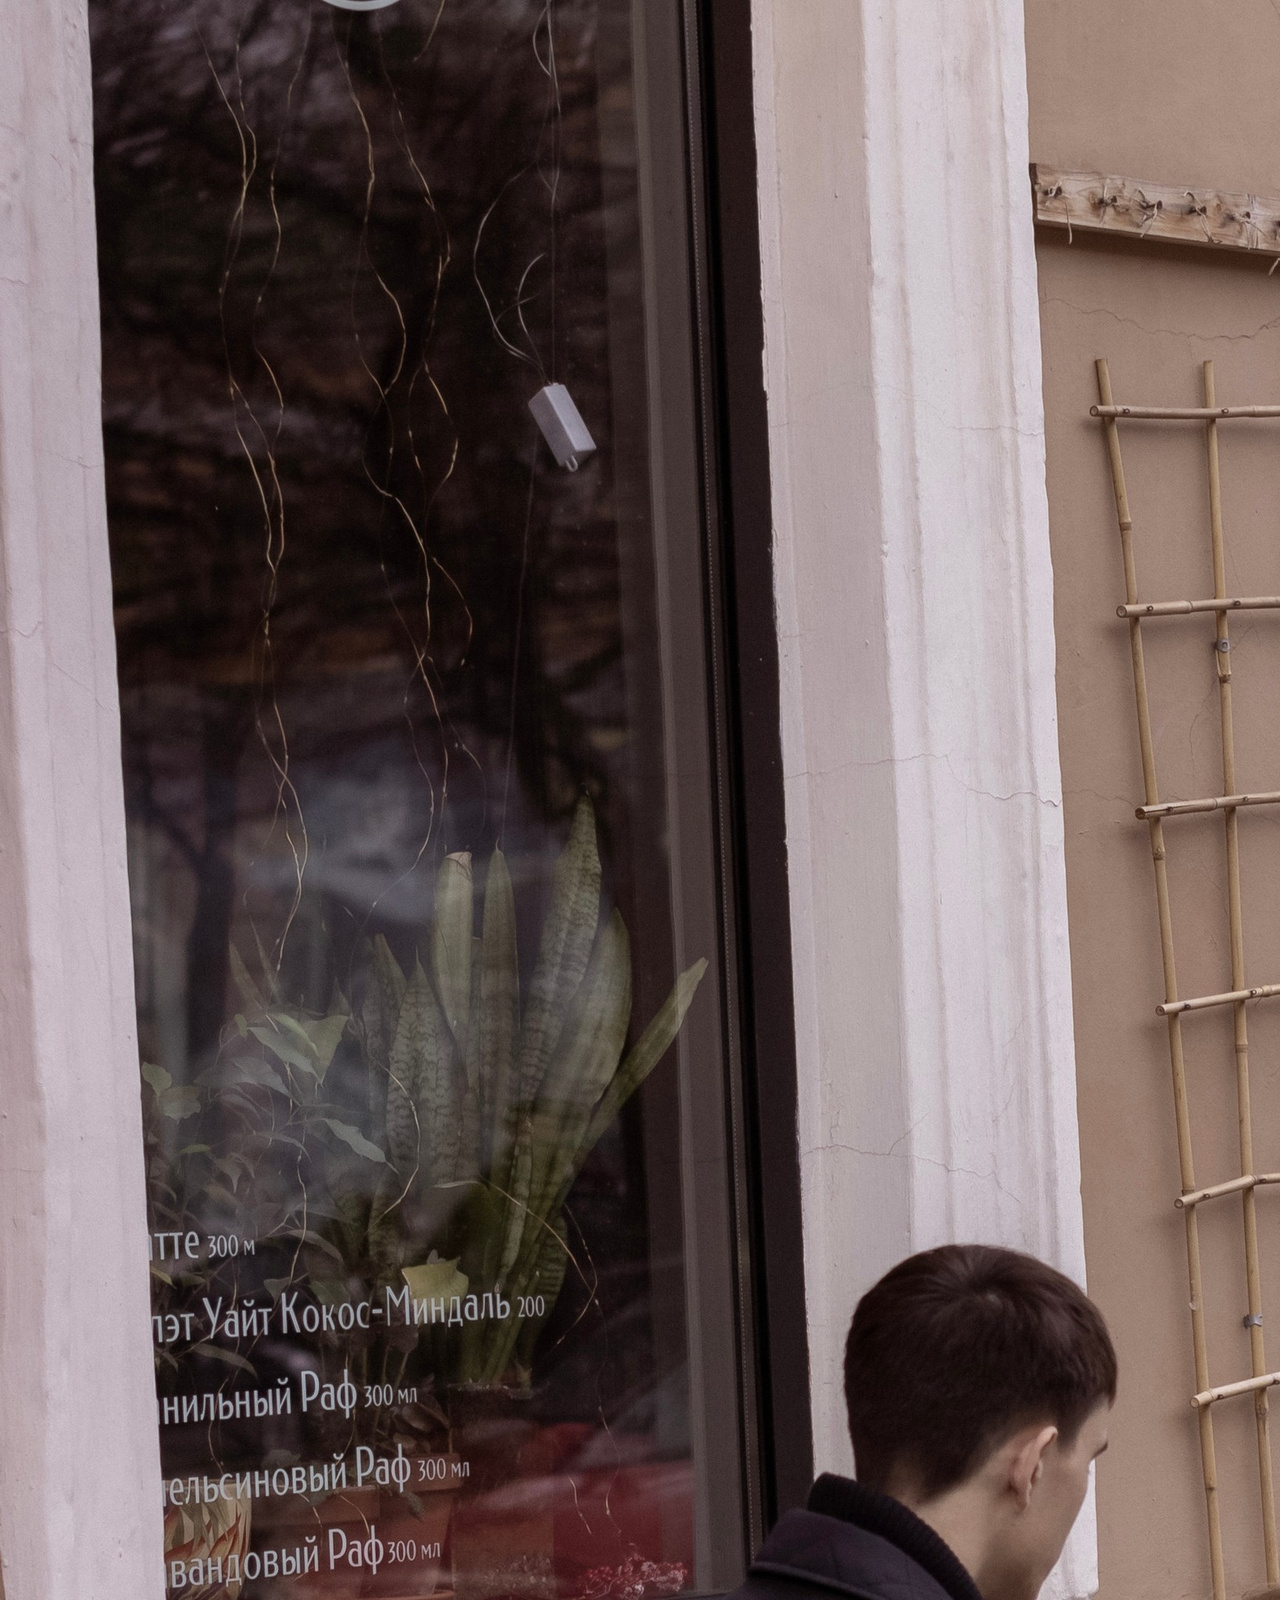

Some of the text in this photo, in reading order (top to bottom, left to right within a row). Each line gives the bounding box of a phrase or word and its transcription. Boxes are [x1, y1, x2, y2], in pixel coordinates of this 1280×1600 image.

[207, 1234, 240, 1259] 300
[243, 1239, 256, 1256] м
[202, 1296, 273, 1340] Уайт
[281, 1285, 511, 1334] Кокос-Миндаль
[517, 1295, 546, 1319] 200
[156, 1369, 418, 1425] нильный Раф 300 мл
[356, 1443, 412, 1494] Раф
[417, 1458, 447, 1482] 300
[451, 1461, 470, 1479] мл
[164, 1524, 441, 1590] вандовый Раф 300 мл
